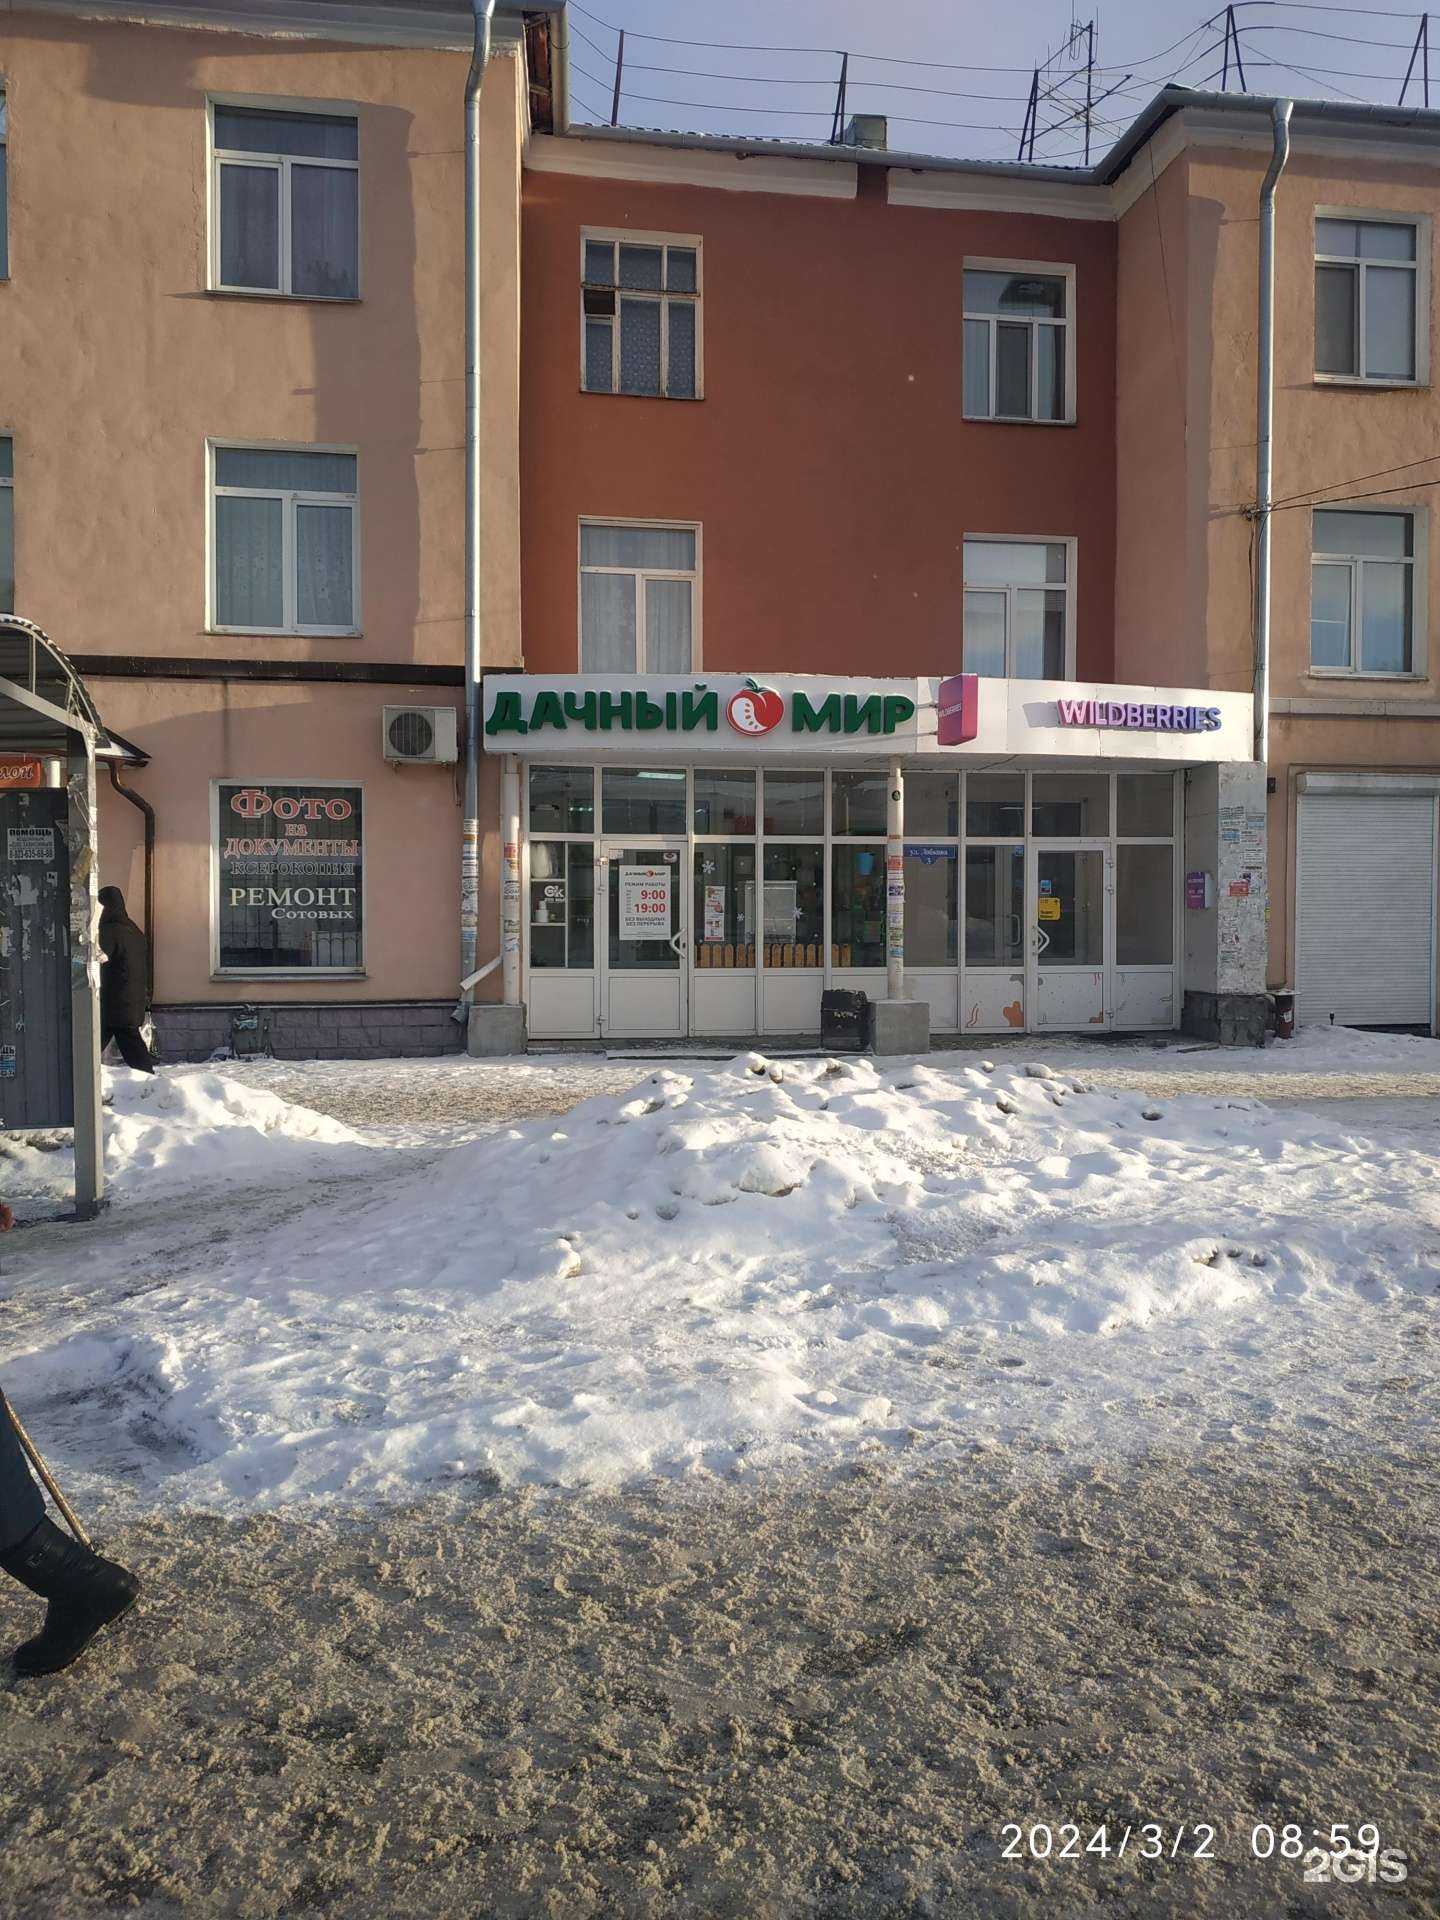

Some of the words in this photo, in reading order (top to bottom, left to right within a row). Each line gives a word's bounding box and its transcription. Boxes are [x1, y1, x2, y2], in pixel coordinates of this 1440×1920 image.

[485, 683, 719, 735] ДАЧНЫЙ
[791, 691, 915, 735] МИР
[1057, 699, 1222, 733] WILDBERRIES
[230, 789, 352, 820] Фото
[285, 823, 308, 836] на
[223, 837, 359, 859] ДОКУМЕНТЫ
[230, 861, 356, 876] КСЕРОКОПИЯ
[229, 887, 357, 906] РЕМОНТ
[641, 889, 666, 900] 9:00
[271, 907, 354, 919] Сотовых
[634, 903, 666, 913] 19:00
